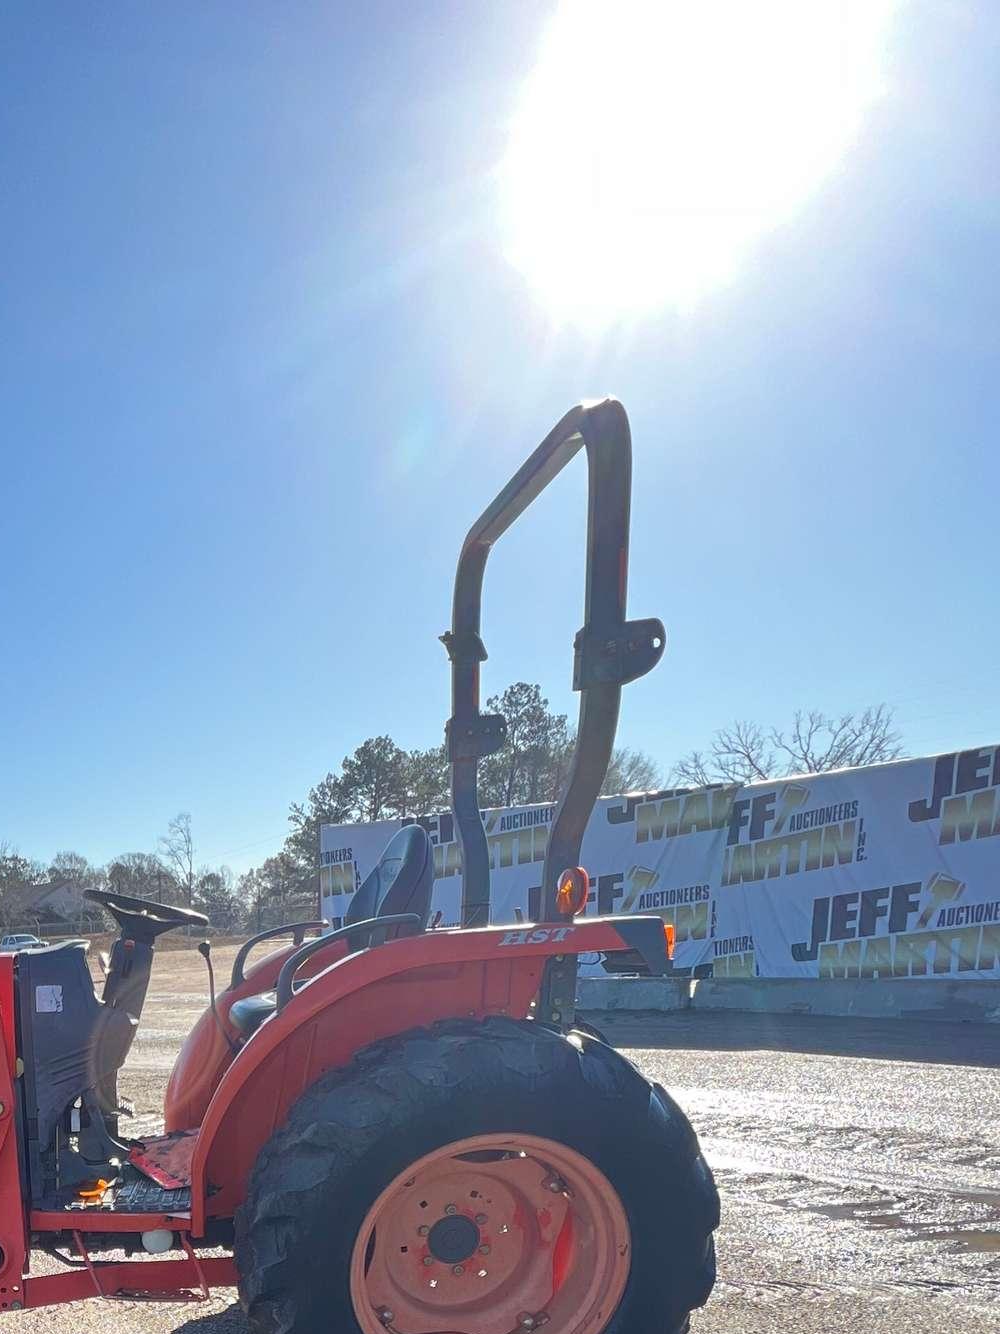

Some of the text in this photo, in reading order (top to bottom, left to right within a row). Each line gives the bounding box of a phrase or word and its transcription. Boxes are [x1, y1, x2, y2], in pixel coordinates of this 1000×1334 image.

[907, 745, 1000, 823] JE
[789, 800, 859, 833] AUCTIONEERS
[638, 884, 711, 911] AUCTIONEERS
[498, 926, 577, 947] HST
[791, 881, 923, 962] JEFF
